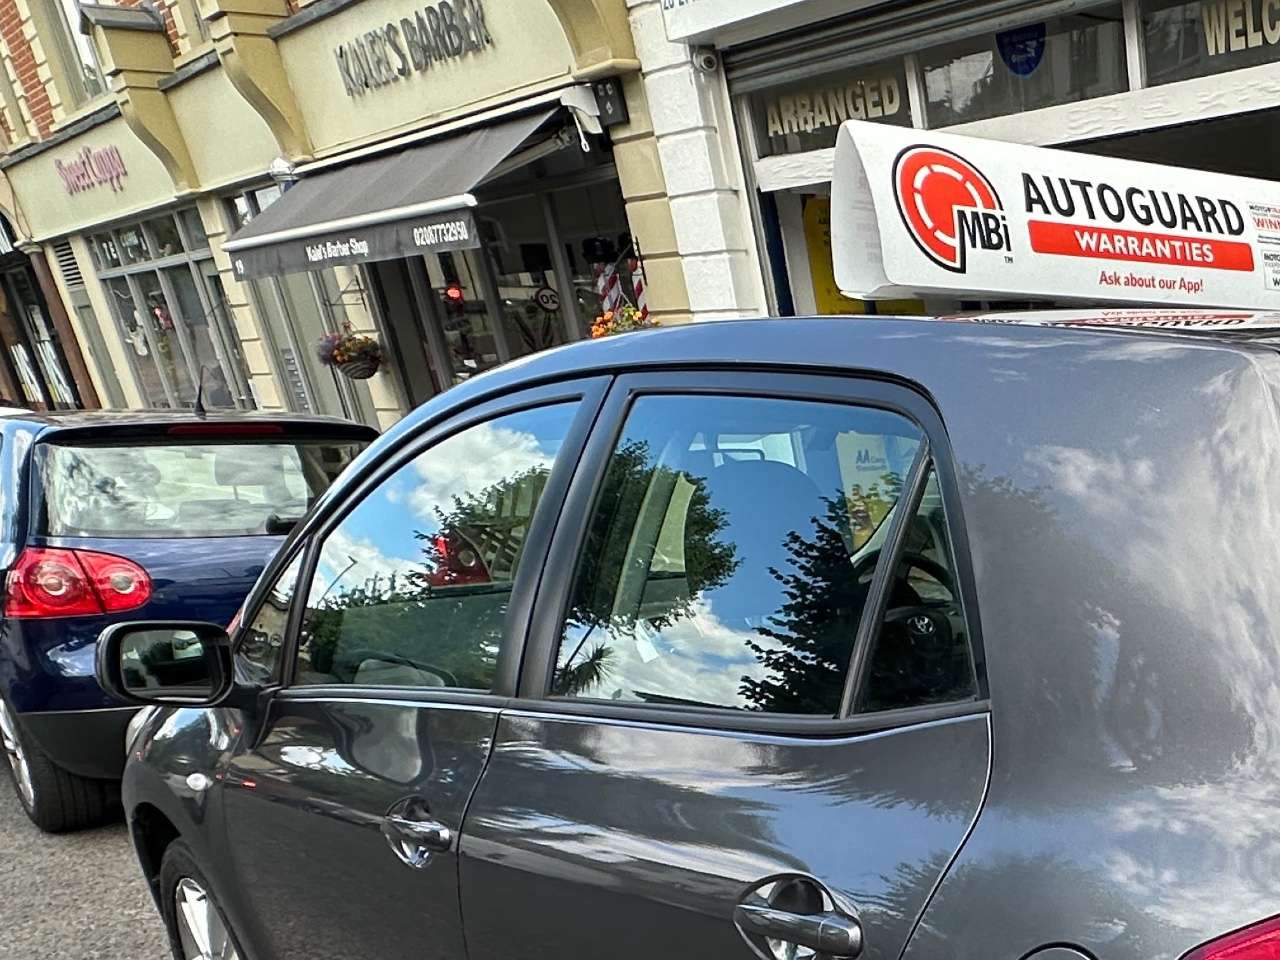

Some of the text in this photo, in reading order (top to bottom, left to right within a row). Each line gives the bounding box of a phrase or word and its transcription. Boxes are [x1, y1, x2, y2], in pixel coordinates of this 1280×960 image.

[400, 0, 494, 71] BARBER
[767, 77, 900, 137] ARRANGED
[1022, 173, 1244, 236] AUTOGUARD
[349, 238, 369, 257] Shop
[957, 209, 1012, 262] MBi
[1074, 230, 1214, 263] WARRANTIES
[1099, 271, 1204, 294] Ask about our App!
